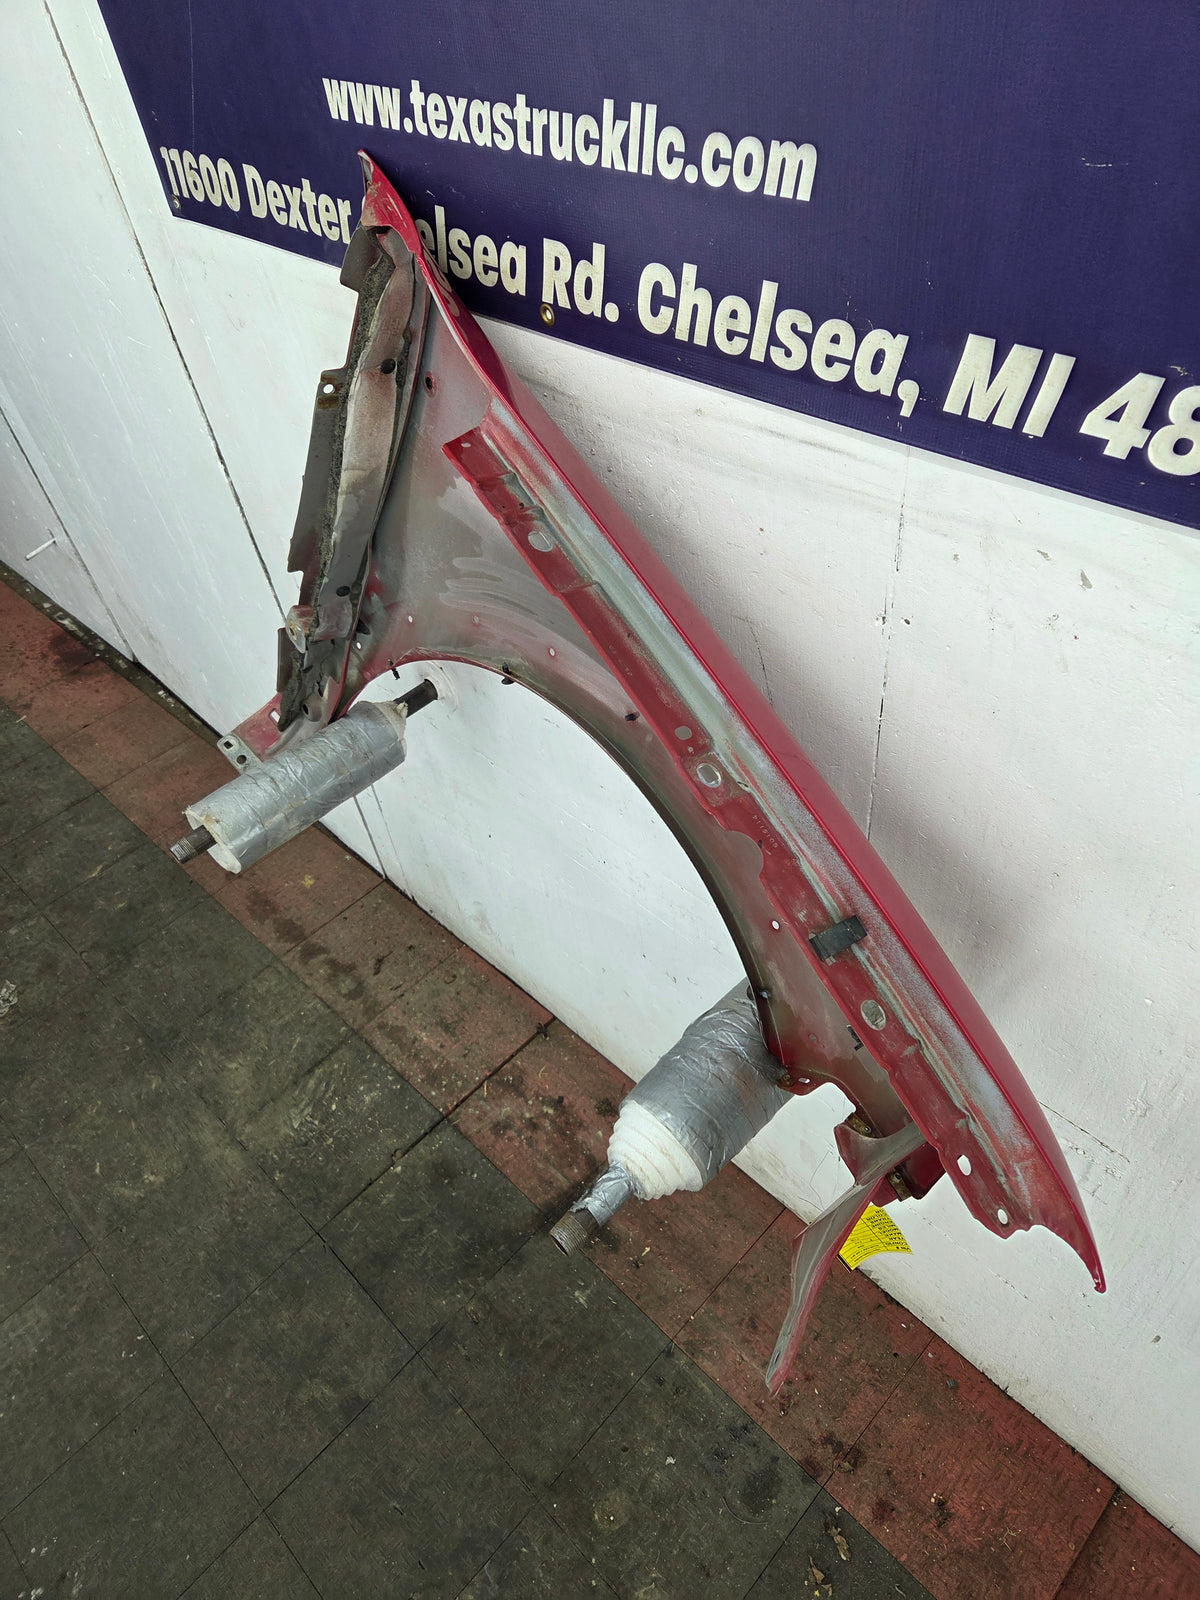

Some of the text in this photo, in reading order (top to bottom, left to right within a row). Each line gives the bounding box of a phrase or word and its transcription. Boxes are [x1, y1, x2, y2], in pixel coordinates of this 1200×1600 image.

[322, 78, 818, 202] www.texastruckllc.com
[160, 147, 241, 212] 11600
[242, 164, 352, 244] Dexter
[542, 237, 620, 323] Rd.
[637, 262, 920, 418] Chelsea,
[942, 333, 1077, 438] MI
